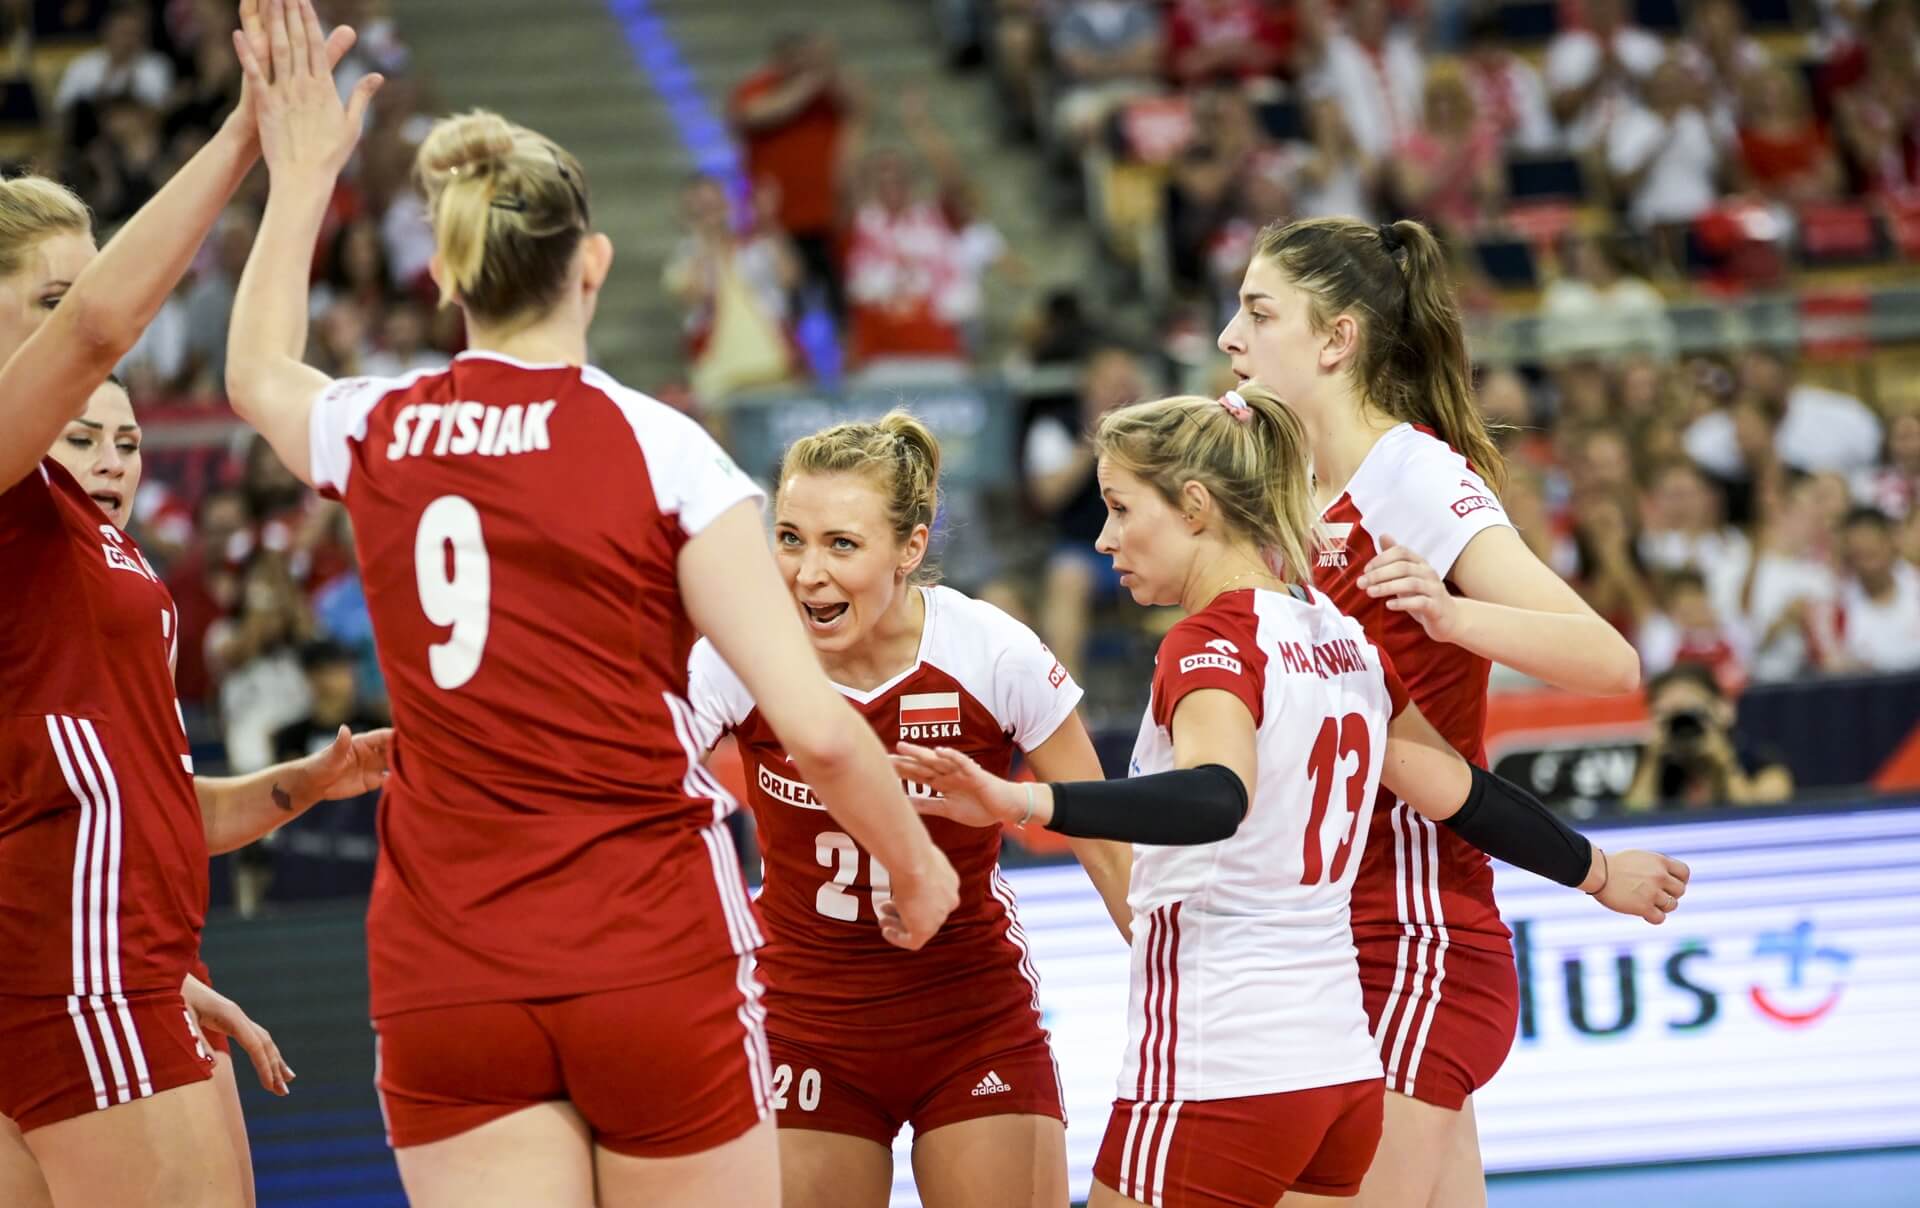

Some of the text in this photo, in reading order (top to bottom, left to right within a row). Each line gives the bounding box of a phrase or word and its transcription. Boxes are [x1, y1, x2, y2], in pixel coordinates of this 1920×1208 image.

[415, 494, 491, 690] 9
[1183, 656, 1238, 671] ORLEN
[900, 723, 962, 740] POLSKA
[1300, 712, 1371, 885] 13
[771, 1063, 822, 1112] 20
[971, 1082, 1012, 1097] adidas
